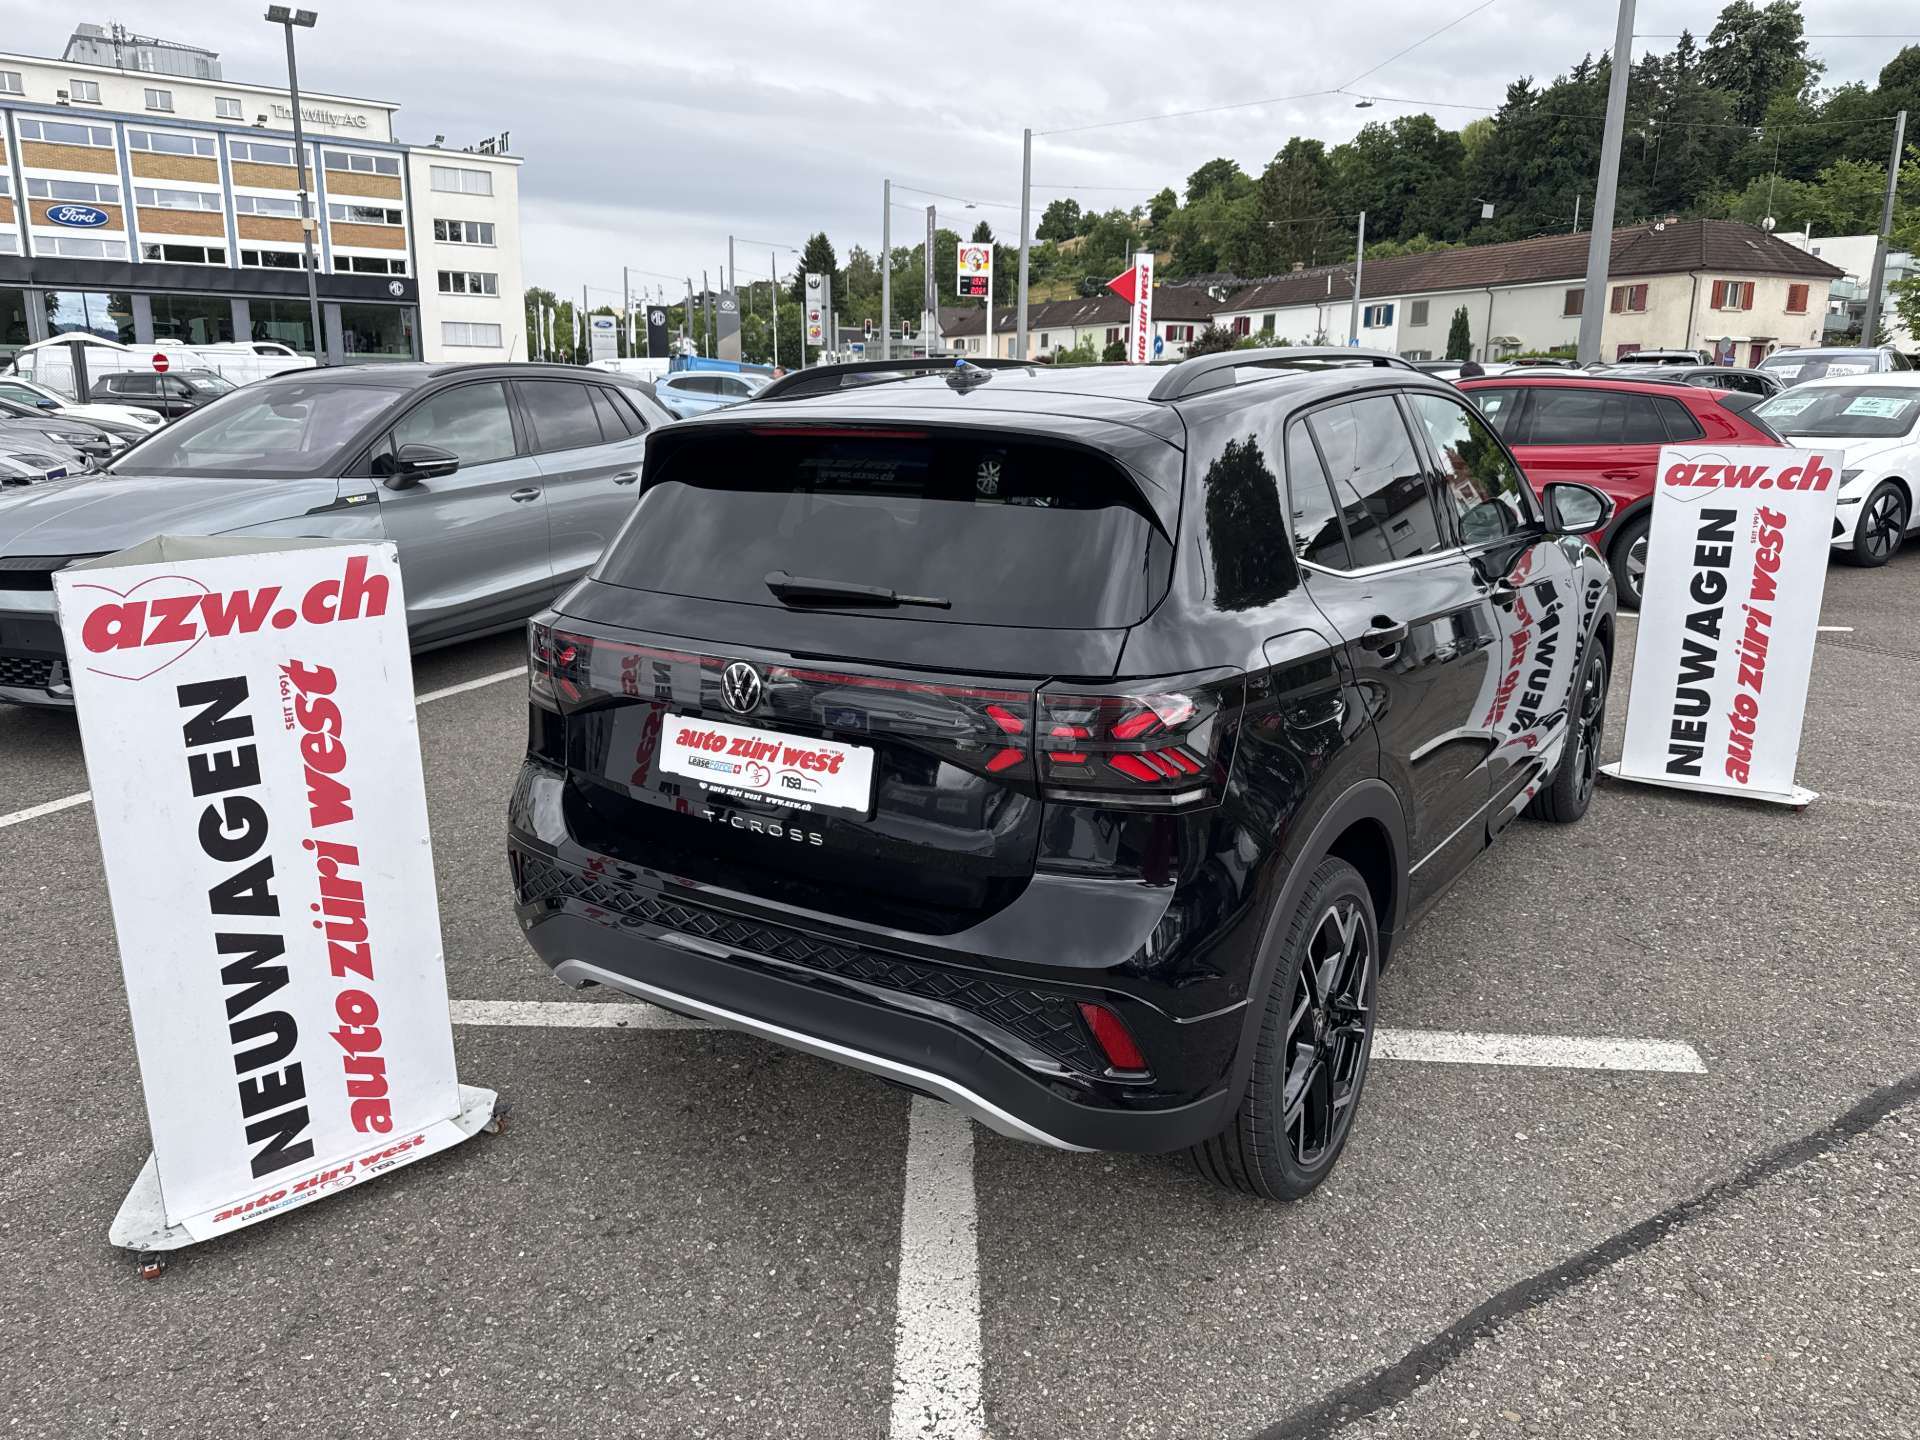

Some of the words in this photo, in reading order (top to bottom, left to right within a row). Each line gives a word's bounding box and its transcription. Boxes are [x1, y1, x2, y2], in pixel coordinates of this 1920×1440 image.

[300, 107, 339, 129] Willy
[343, 113, 369, 129] AG
[58, 206, 97, 224] Ford
[1654, 222, 1665, 231] 48
[1141, 264, 1150, 300] west
[650, 310, 666, 327] MG
[1138, 335, 1147, 361] uto
[1664, 456, 1833, 491] azw.ch
[1750, 505, 1787, 602] west
[82, 556, 390, 653] azw.ch
[1665, 508, 1737, 777] NEUWAGEN
[1735, 604, 1772, 693] züri
[279, 674, 291, 702] 1991
[283, 706, 295, 731] SEIT
[278, 658, 353, 829] west
[675, 728, 728, 753] auto
[726, 737, 782, 763] züri
[783, 747, 845, 775] west
[1725, 693, 1759, 785] auto
[708, 785, 726, 794] auto
[726, 788, 743, 798] züri
[744, 791, 762, 801] west
[765, 796, 812, 811] www.azw.ch
[781, 775, 802, 791] nsa
[702, 809, 823, 846] T-CROSS
[177, 675, 315, 1180] NEUWAGEN
[301, 838, 374, 981] züri
[328, 989, 393, 1134] auto
[212, 1189, 288, 1223] auto
[292, 1161, 355, 1195] züri
[359, 1134, 426, 1167] west
